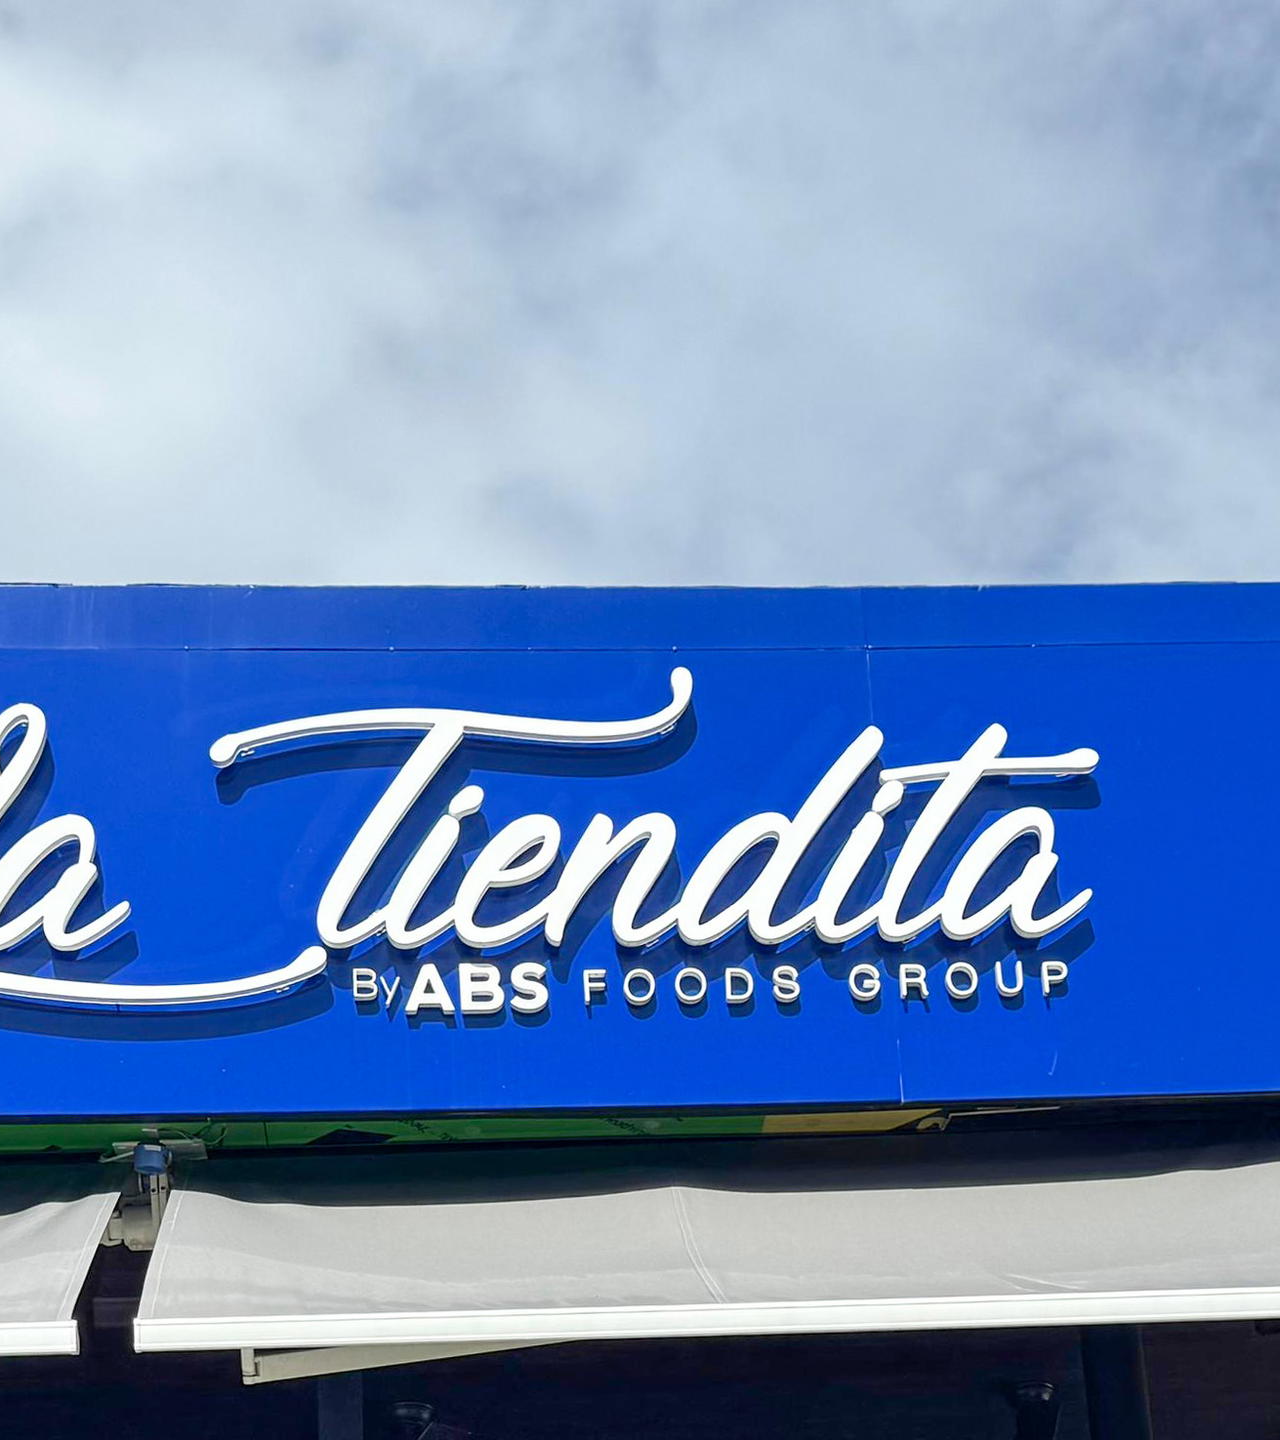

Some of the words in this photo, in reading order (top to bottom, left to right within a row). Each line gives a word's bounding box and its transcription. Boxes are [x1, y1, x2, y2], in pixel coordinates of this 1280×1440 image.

[208, 664, 1102, 951] Tiendita
[352, 967, 401, 1009] By
[404, 961, 550, 1016] ABS
[582, 964, 802, 1007] FOODS
[847, 960, 1069, 1002] GROUP
